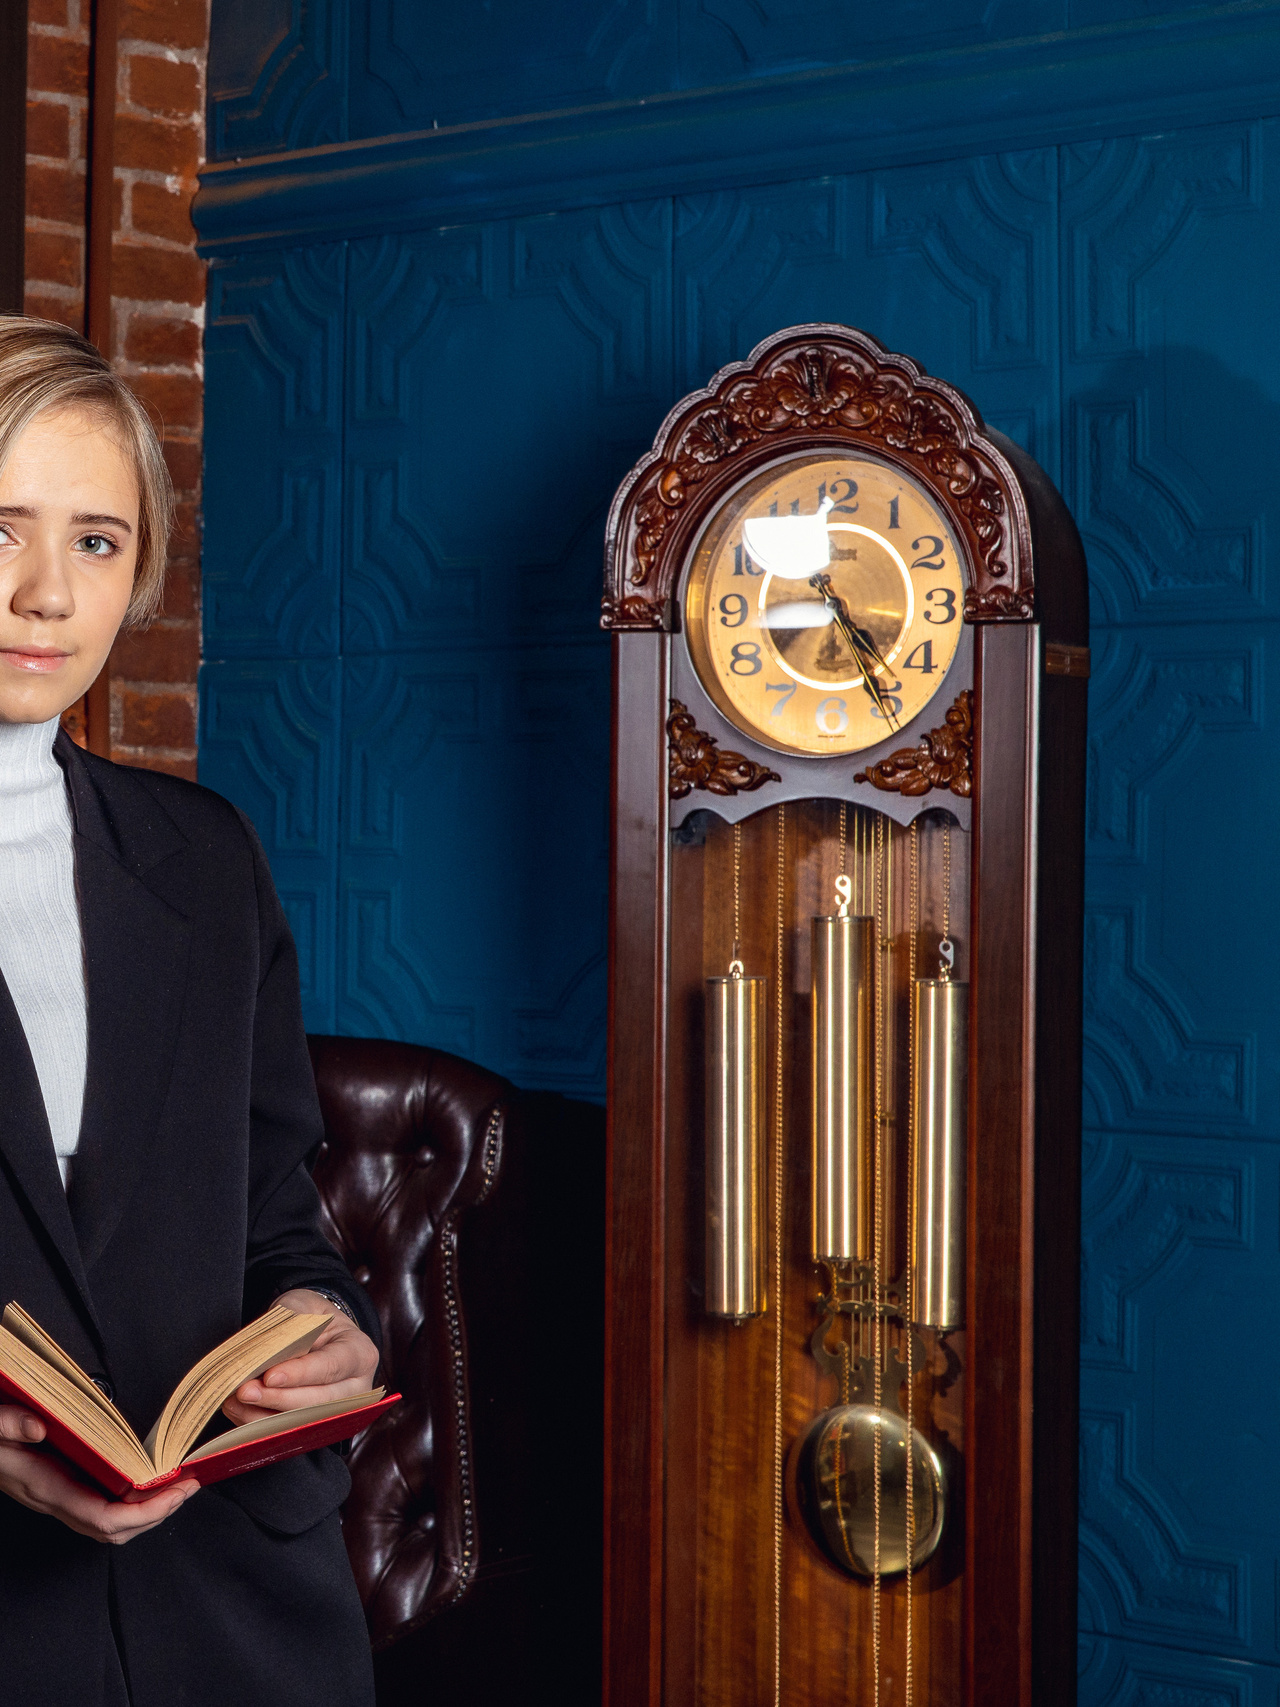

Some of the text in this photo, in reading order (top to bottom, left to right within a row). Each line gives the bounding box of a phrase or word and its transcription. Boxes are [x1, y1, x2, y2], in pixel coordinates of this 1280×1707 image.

[816, 478, 859, 514] 12
[887, 494, 901, 530] 1
[910, 535, 946, 571] 2
[719, 593, 749, 628] 9
[923, 587, 957, 625] 3
[729, 641, 763, 677] 8
[903, 639, 939, 675] 4
[766, 681, 797, 717] 7
[815, 696, 850, 735] 6
[870, 681, 904, 720] 5
